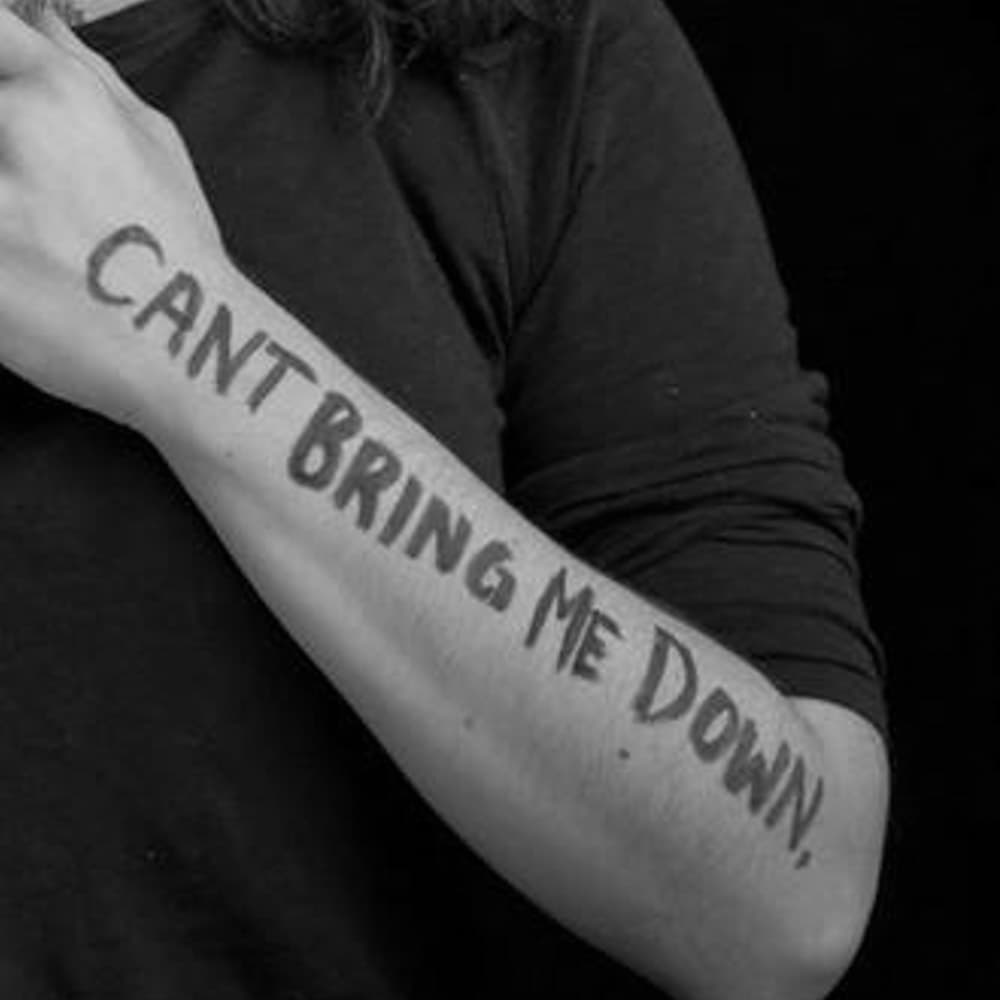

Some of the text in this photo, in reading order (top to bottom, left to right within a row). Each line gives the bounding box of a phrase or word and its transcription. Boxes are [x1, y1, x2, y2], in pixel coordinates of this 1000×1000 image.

[86, 224, 318, 414] CANT
[287, 391, 517, 612] BRING
[524, 566, 624, 683] ME
